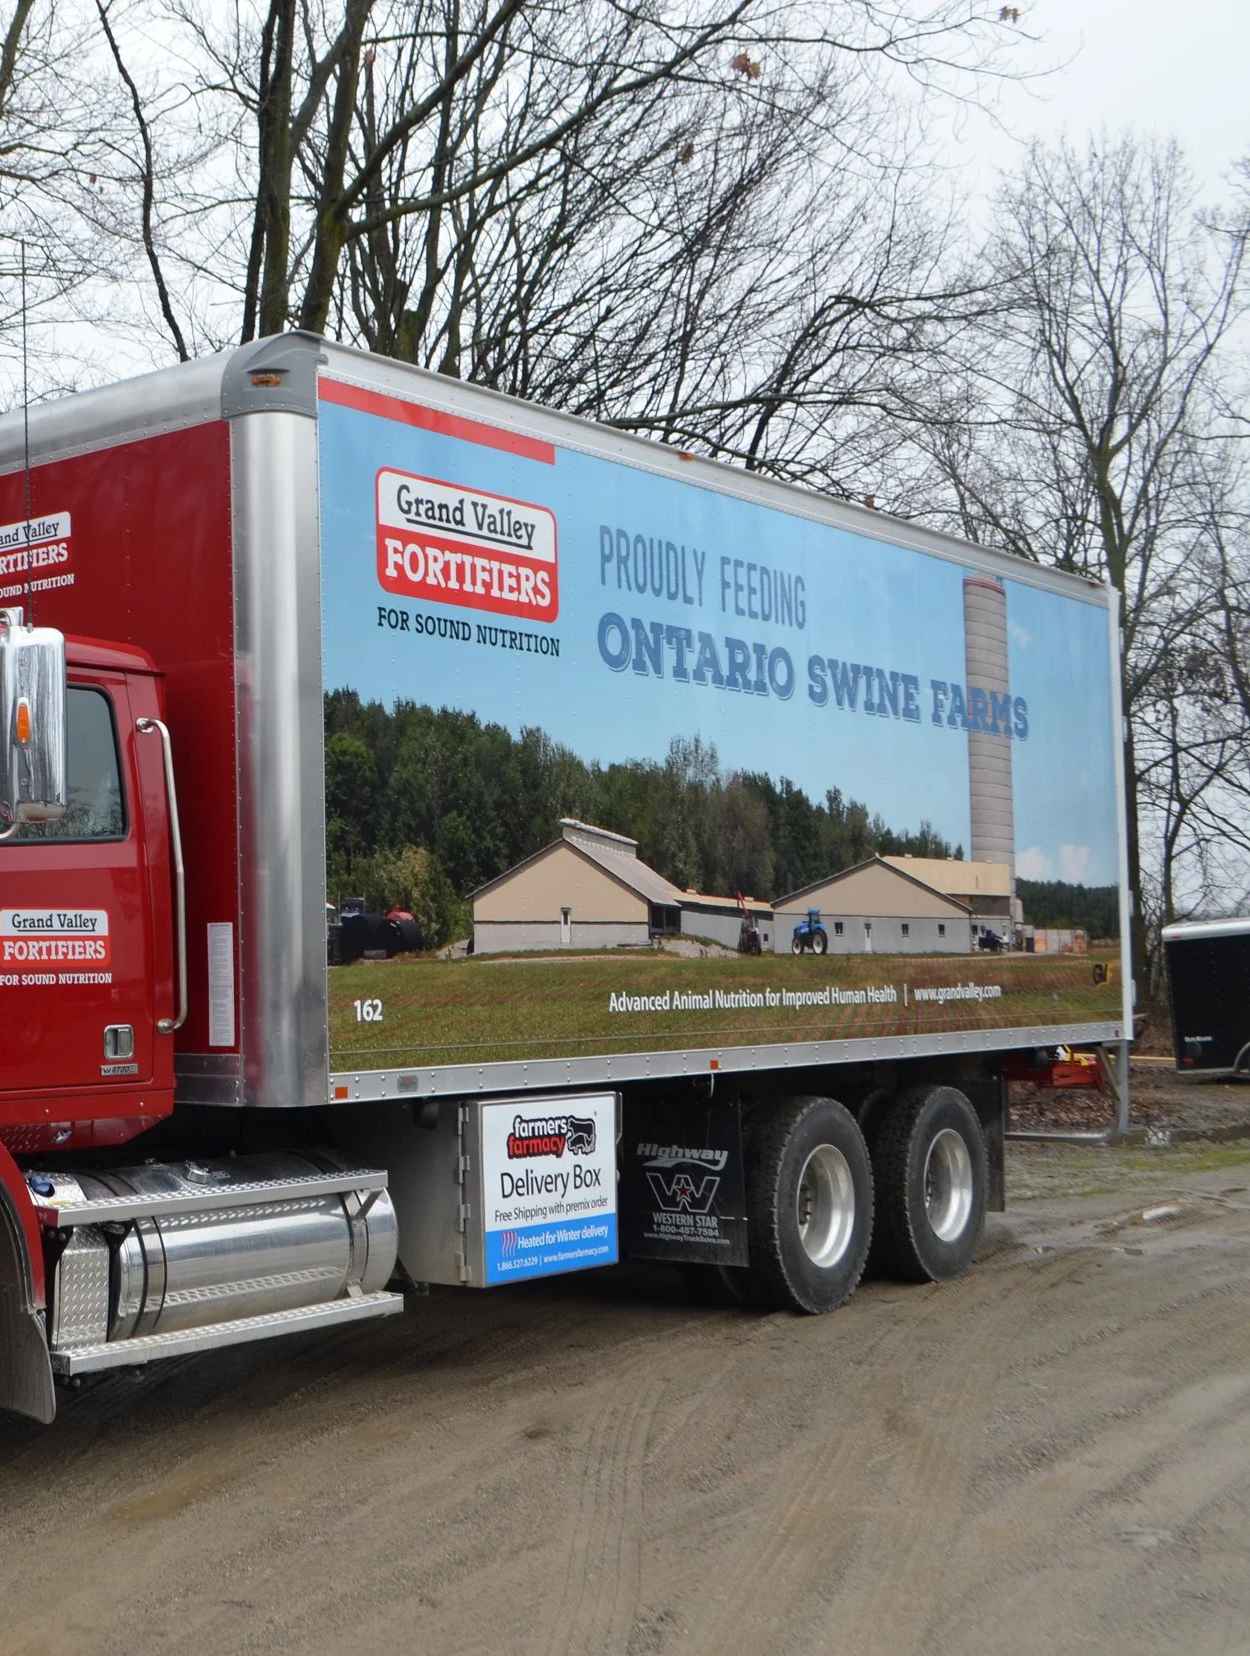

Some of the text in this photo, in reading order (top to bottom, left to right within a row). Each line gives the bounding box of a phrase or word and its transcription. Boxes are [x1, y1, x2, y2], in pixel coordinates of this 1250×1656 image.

[23, 521, 60, 539] Valley
[397, 484, 535, 550] Grand Valley
[24, 573, 75, 594] NUTRITION
[385, 538, 551, 607] FORTIFIERS
[600, 524, 806, 630] PROUDLY FEEDING
[377, 607, 560, 657] FOR SOUND NUTRITION
[597, 612, 1030, 741] ONTARIO SWINE FARMS
[12, 913, 97, 932] Grand Valley
[2, 940, 106, 960] FORTIFIERS
[22, 974, 56, 985] SOUND
[58, 973, 112, 984] NUTRITION
[609, 982, 1001, 1012] Advanced Animal Nutrition for Improved Human Health www.grandvalley.com
[353, 999, 383, 1022] 162
[513, 1116, 568, 1138] farmers
[509, 1135, 565, 1155] farmacy
[636, 1143, 729, 1170] Highway
[500, 1164, 601, 1199] Delivery Box
[494, 1194, 609, 1222] Free Shipping with premix order
[653, 1212, 718, 1228] WESTERN STAR
[518, 1224, 609, 1250] Heated for Winter delivery
